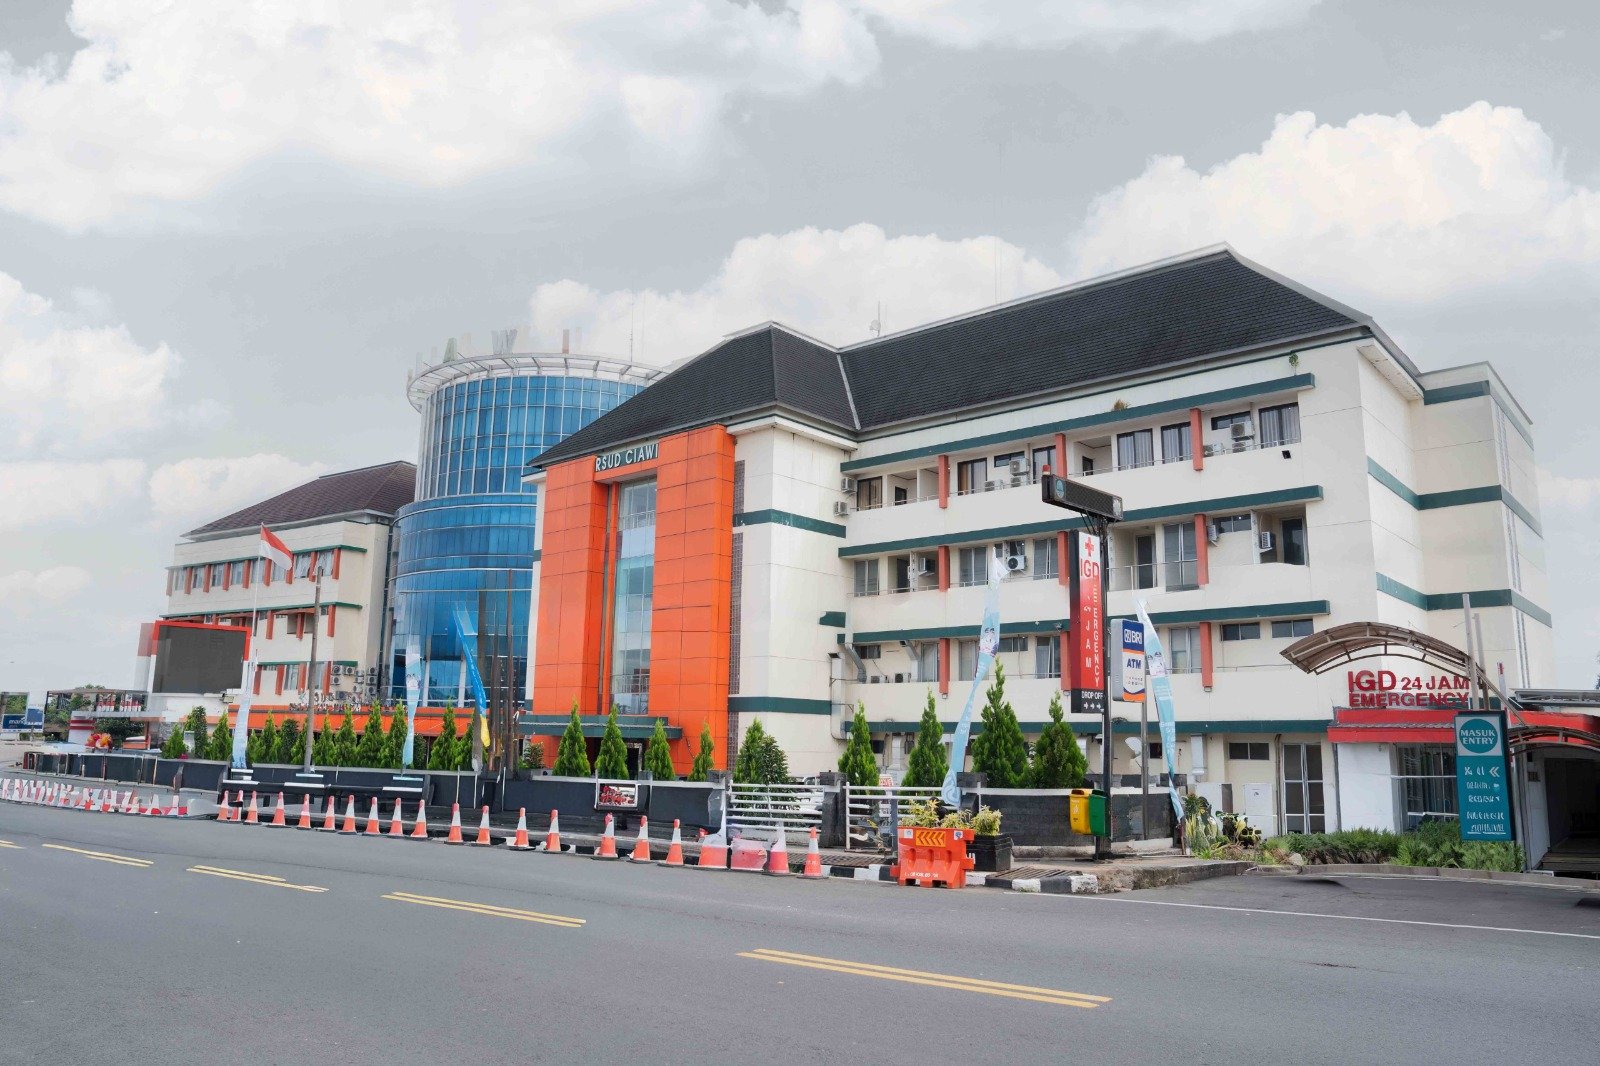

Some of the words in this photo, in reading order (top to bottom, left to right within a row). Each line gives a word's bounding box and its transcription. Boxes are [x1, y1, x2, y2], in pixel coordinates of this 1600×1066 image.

[595, 454, 621, 472] RSUD
[625, 443, 659, 464] CIAWI
[1080, 558, 1100, 578] IGD
[1131, 630, 1143, 645] BRI
[1126, 658, 1142, 670] ATM
[1347, 670, 1397, 692] IGD
[1400, 676, 1423, 691] 24
[1425, 675, 1470, 690] JAM
[1081, 690, 1094, 699] DROP
[1094, 691, 1103, 700] OFF
[1349, 691, 1470, 707] EMERGENCY
[1460, 729, 1496, 737] MASUK
[1462, 737, 1495, 745] ENTRY
